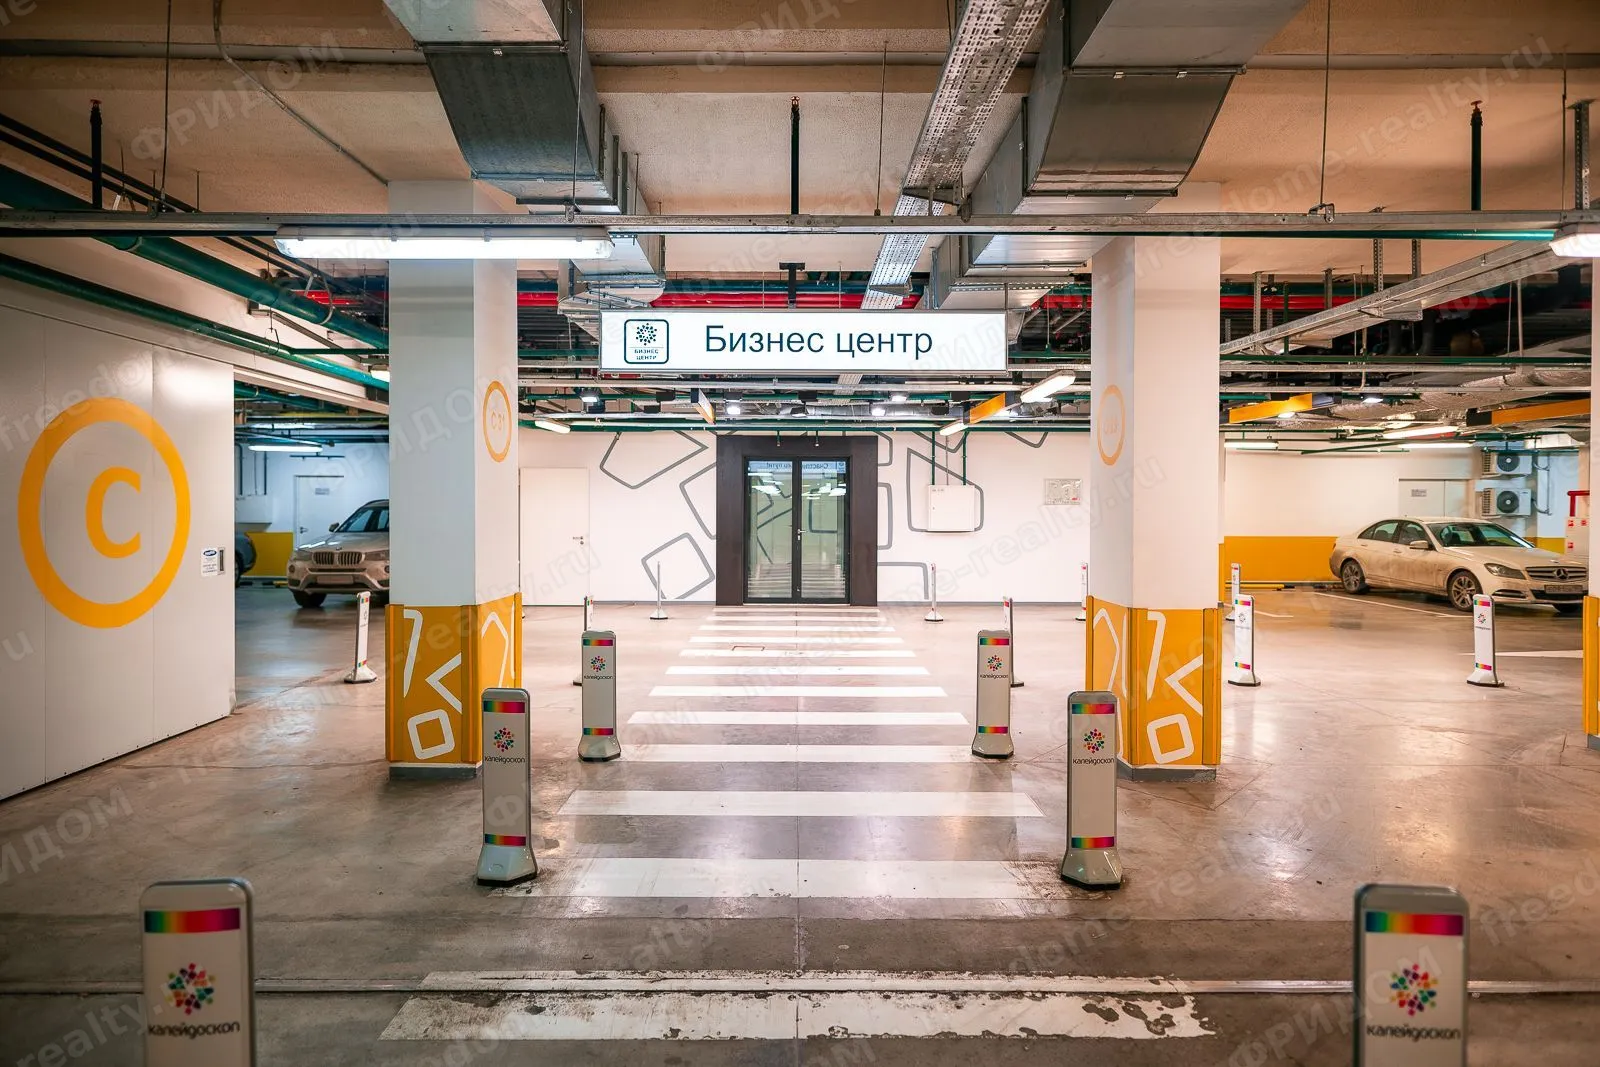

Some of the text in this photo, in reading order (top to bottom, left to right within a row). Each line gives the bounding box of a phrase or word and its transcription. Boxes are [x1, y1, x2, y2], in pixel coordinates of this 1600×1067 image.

[706, 325, 933, 360] Бизнес центр
[147, 1021, 240, 1040] калейдоскоп
[1366, 1023, 1460, 1042] калейдоскоп
